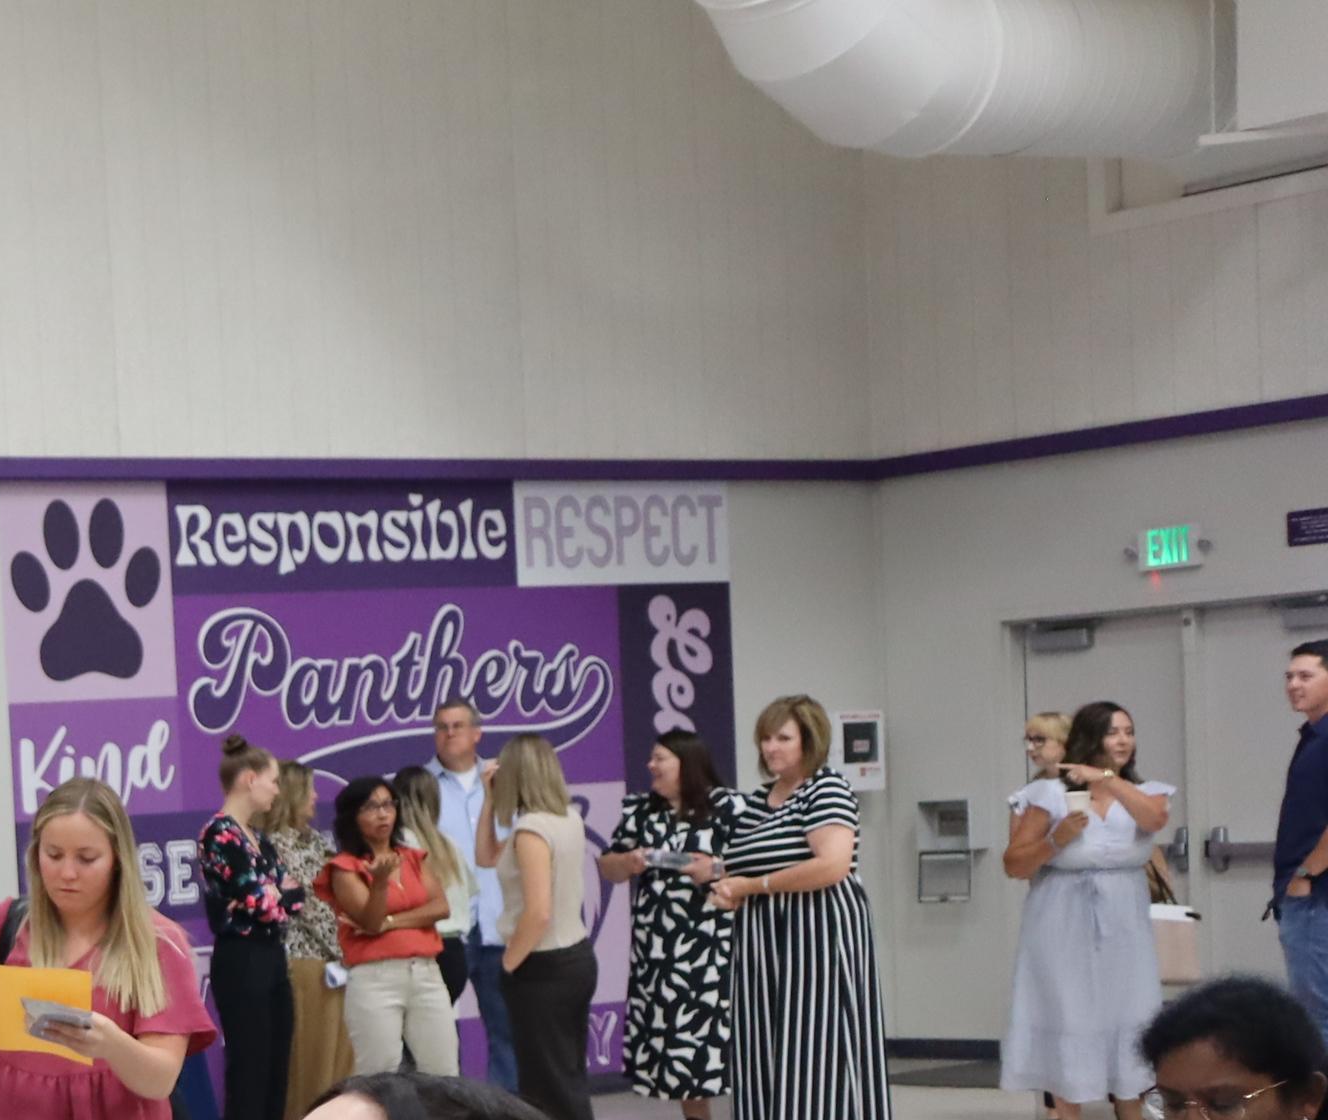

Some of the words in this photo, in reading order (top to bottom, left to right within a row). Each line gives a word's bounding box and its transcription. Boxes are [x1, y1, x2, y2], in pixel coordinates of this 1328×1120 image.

[175, 493, 507, 575] Responsible
[523, 494, 723, 568] RESPECT
[1146, 525, 1190, 566] EXIT
[187, 602, 614, 735] Panthers
[19, 719, 175, 815] Kind
